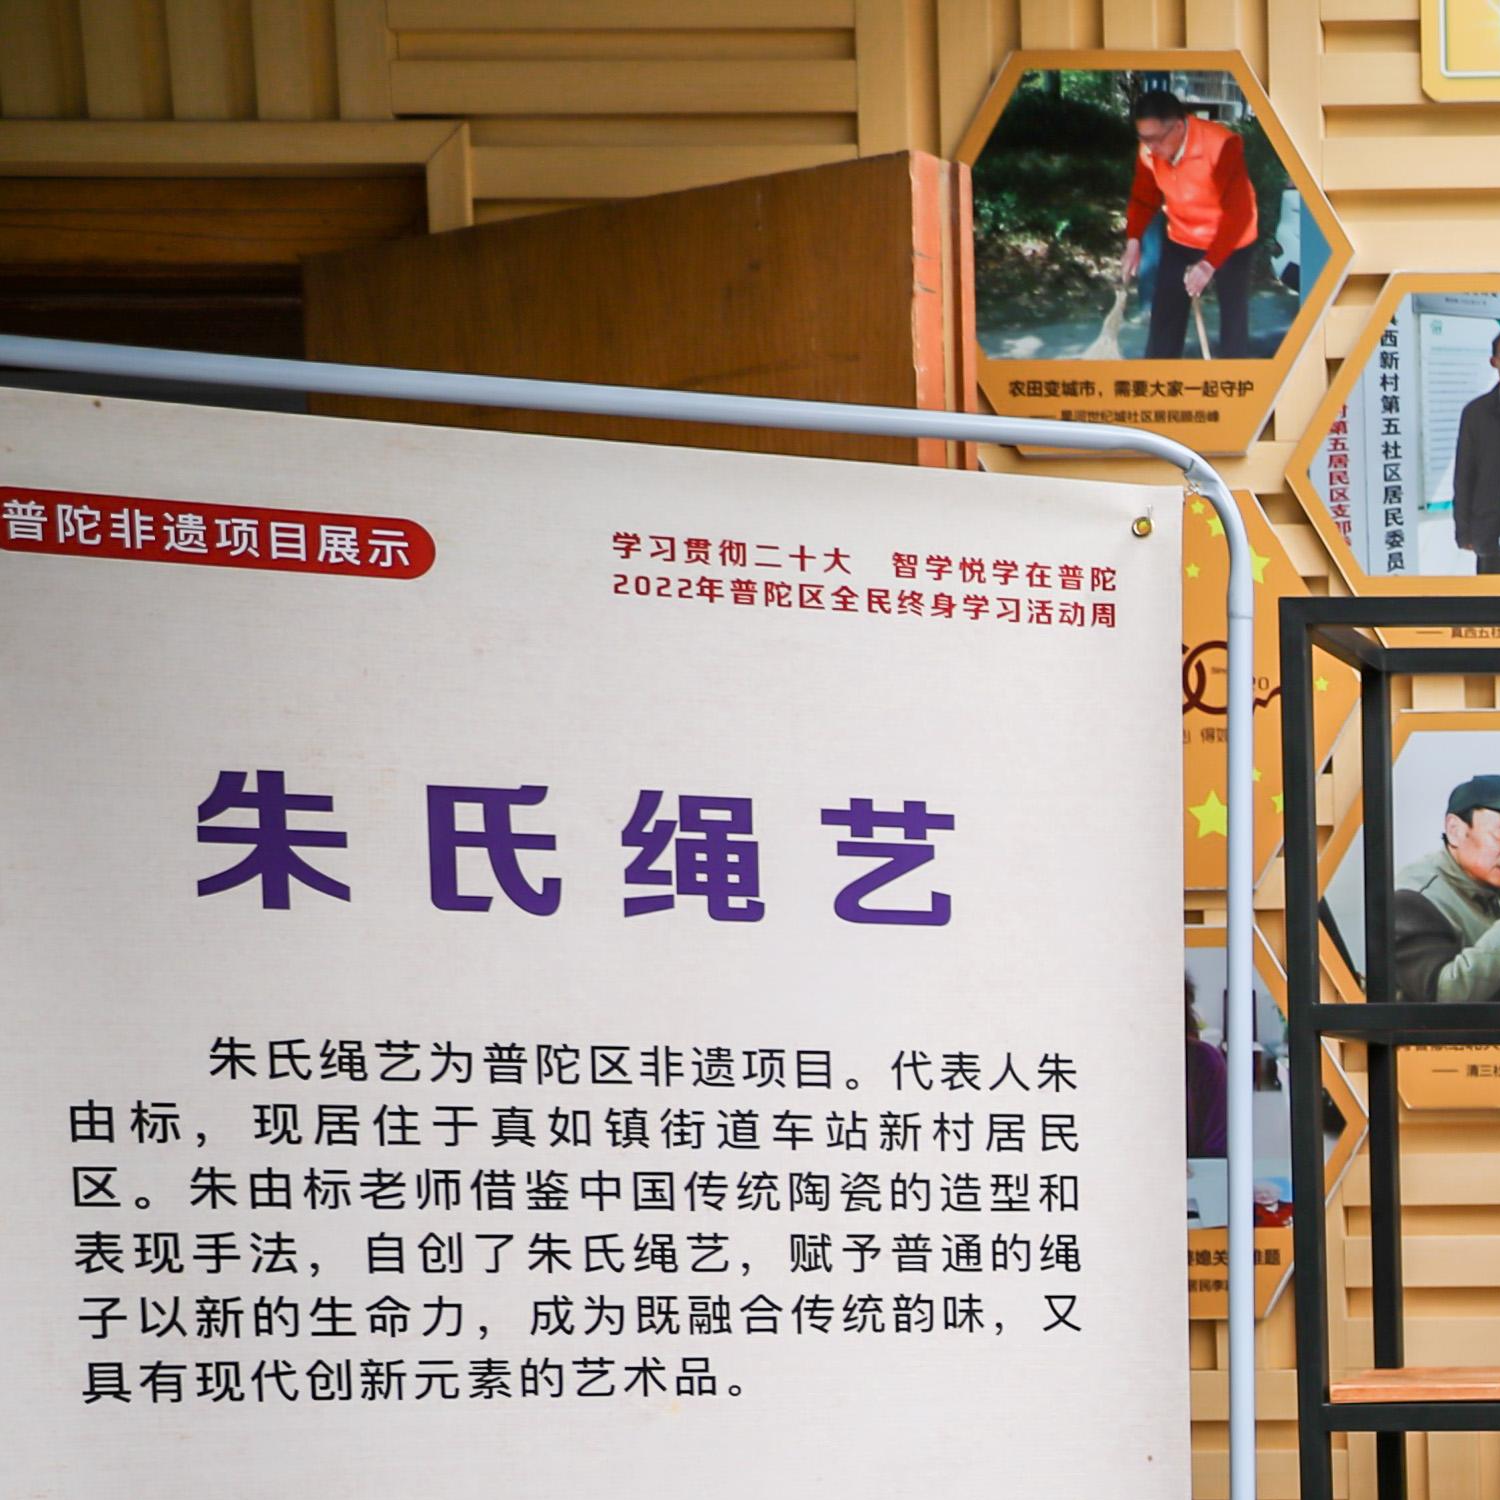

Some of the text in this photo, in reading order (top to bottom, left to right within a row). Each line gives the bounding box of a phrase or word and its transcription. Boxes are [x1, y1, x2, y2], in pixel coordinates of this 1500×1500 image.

[1009, 380, 1254, 398] 农田变城市，需要大家一起守护
[1380, 313, 1404, 577] 西新村第五社区居民委员
[2, 499, 410, 568] 普陀非遗项目展示
[612, 531, 1118, 592] 学习贯彻二十大 智学悦学在普陀
[613, 573, 1117, 628] 2022年普陀区全民终身学习活动周
[196, 768, 956, 927] 朱氏绳艺
[208, 1036, 1079, 1094] 朱氏绳艺为普陀区非遗项目。代表人朱
[68, 1099, 1081, 1153] 由标，现居住于真如镇街道车站新村居民
[71, 1166, 1080, 1214] 区。朱由标老师借鉴中国传统陶瓷的造型和
[74, 1231, 1082, 1278] 表现手法，自创了朱氏绳艺，赋予普通的绳
[77, 1293, 1083, 1342] 子以新的生命力，成为既融合传统韵味，又
[81, 1356, 752, 1405] 具有现代创新元素的艺术品。
